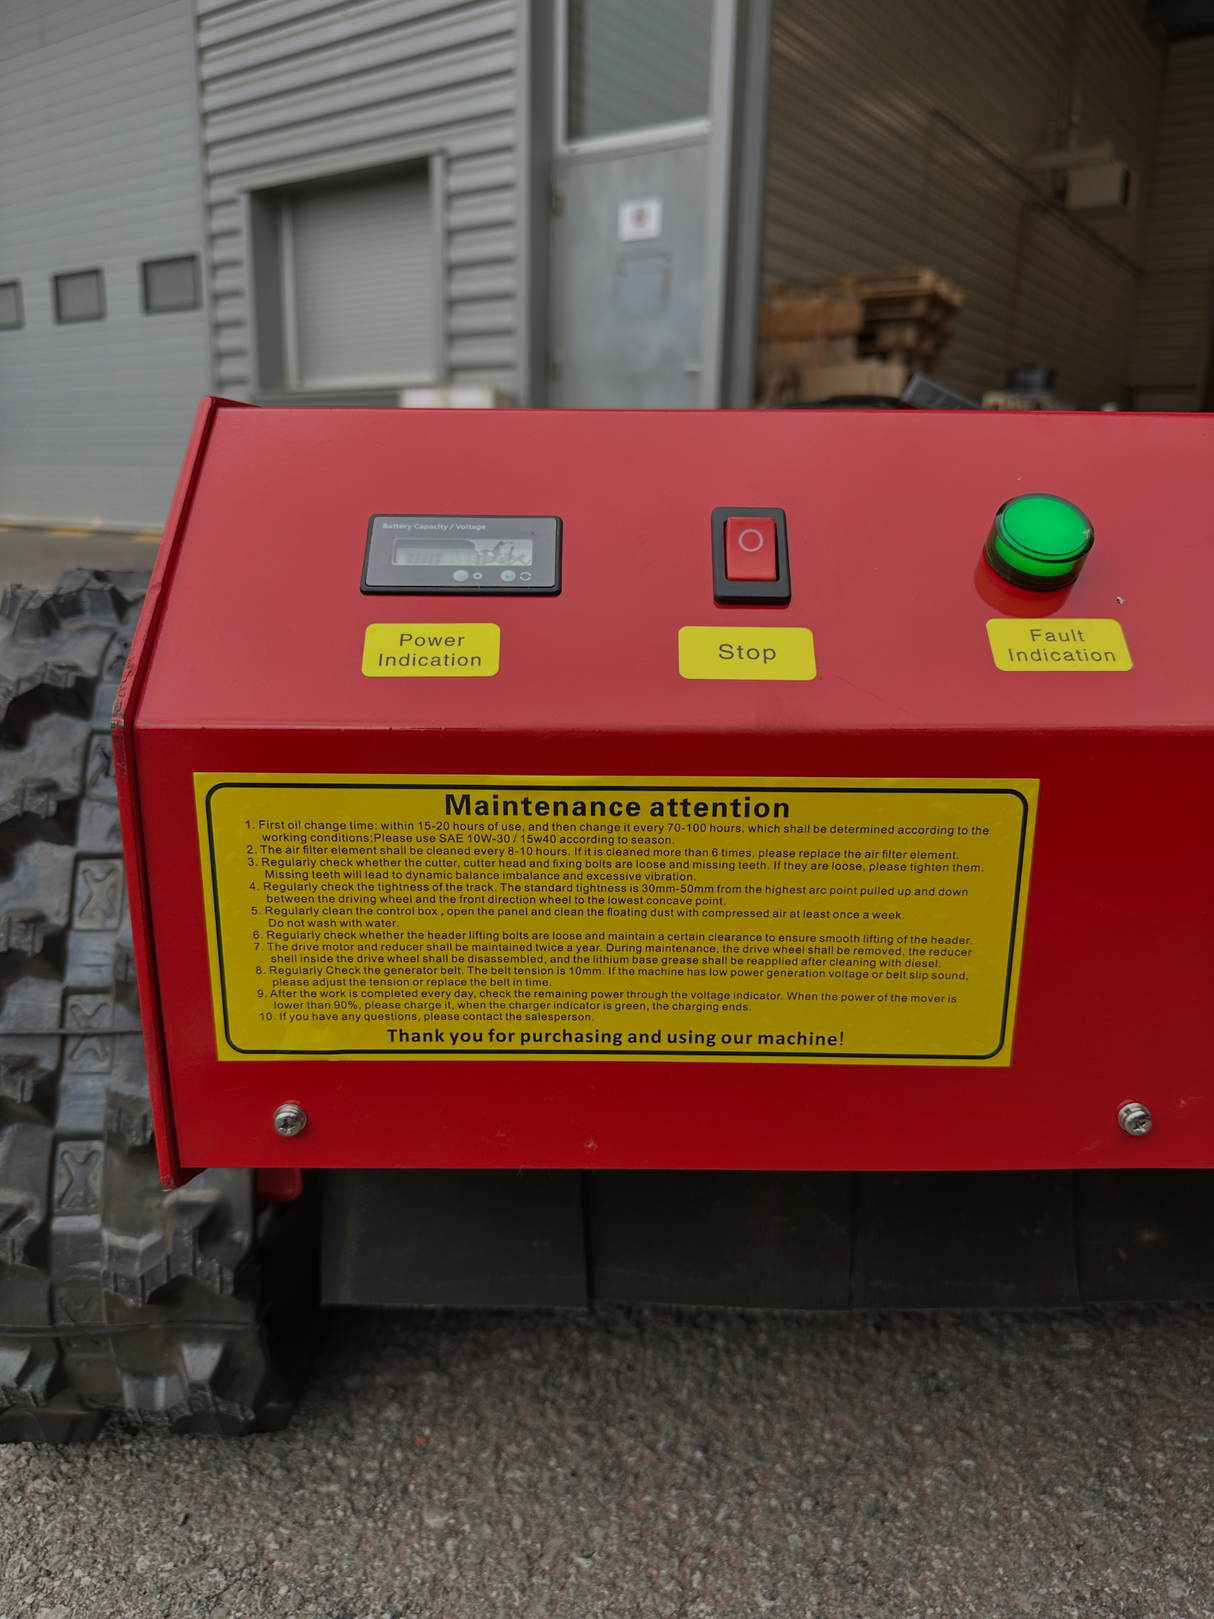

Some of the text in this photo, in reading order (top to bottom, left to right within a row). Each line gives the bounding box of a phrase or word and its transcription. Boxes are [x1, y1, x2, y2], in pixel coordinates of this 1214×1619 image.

[382, 523, 412, 531] Battery
[414, 524, 448, 532] Capacity
[456, 524, 486, 532] Voltage
[399, 633, 465, 647] Power
[1030, 629, 1085, 642] Fault
[378, 653, 482, 667] Indication
[718, 643, 777, 664] Stop
[1008, 648, 1116, 663] Indication
[445, 794, 790, 818] Maintenance attention
[245, 820, 989, 837] 1. First oil change time: within 15-20 hours of use, and then change it every 70-100 hours, which shall be determined according to the
[261, 833, 307, 844] working
[438, 834, 463, 843] SAE
[467, 834, 510, 843] 10W-30
[520, 835, 556, 844] 15w40
[559, 835, 614, 846] according
[617, 835, 628, 844] to
[265, 870, 696, 881] Missing teeth will lead to dynamic balance imbalance and excessive vibration.
[266, 894, 314, 903] between
[317, 894, 335, 903] the
[338, 895, 376, 905] driving
[379, 895, 412, 903] wheel
[415, 895, 436, 904] and
[438, 895, 456, 904] the
[459, 895, 485, 904] front
[487, 895, 536, 904] direction
[538, 896, 571, 904] wheel
[574, 896, 584, 904] to
[587, 896, 604, 904] the
[607, 896, 643, 905] lowest
[695, 897, 725, 907] point.
[268, 919, 398, 927] Do not wash with water.
[252, 931, 263, 939] 6.
[266, 931, 321, 941] Regularly
[323, 931, 356, 939] check
[358, 931, 404, 939] whether
[406, 931, 424, 939] the
[427, 931, 466, 940] header
[469, 931, 499, 942] lifting
[502, 931, 528, 940] bolts
[552, 932, 581, 940] loose
[584, 932, 604, 940] and
[608, 932, 654, 941] maintain
[667, 932, 705, 941] certain
[708, 933, 762, 942] clearance
[765, 933, 775, 942] to
[819, 934, 860, 943] smooth
[862, 935, 893, 945] lifting
[896, 935, 908, 944] of
[910, 935, 928, 944] the
[930, 936, 972, 945] header.
[270, 954, 941, 969] shell inside the drive wheel shall be disassembled, and the lithium base grease shall be reapplied after cleaning with diesel.
[274, 1001, 750, 1012] lower than 90%, please charge it, when the charger indicator is green, the charging ends.
[259, 1012, 593, 1023] 10. If you have any questions, please contact the salesperson.
[387, 1028, 844, 1047] Thank you for purchasing and using our machine!
